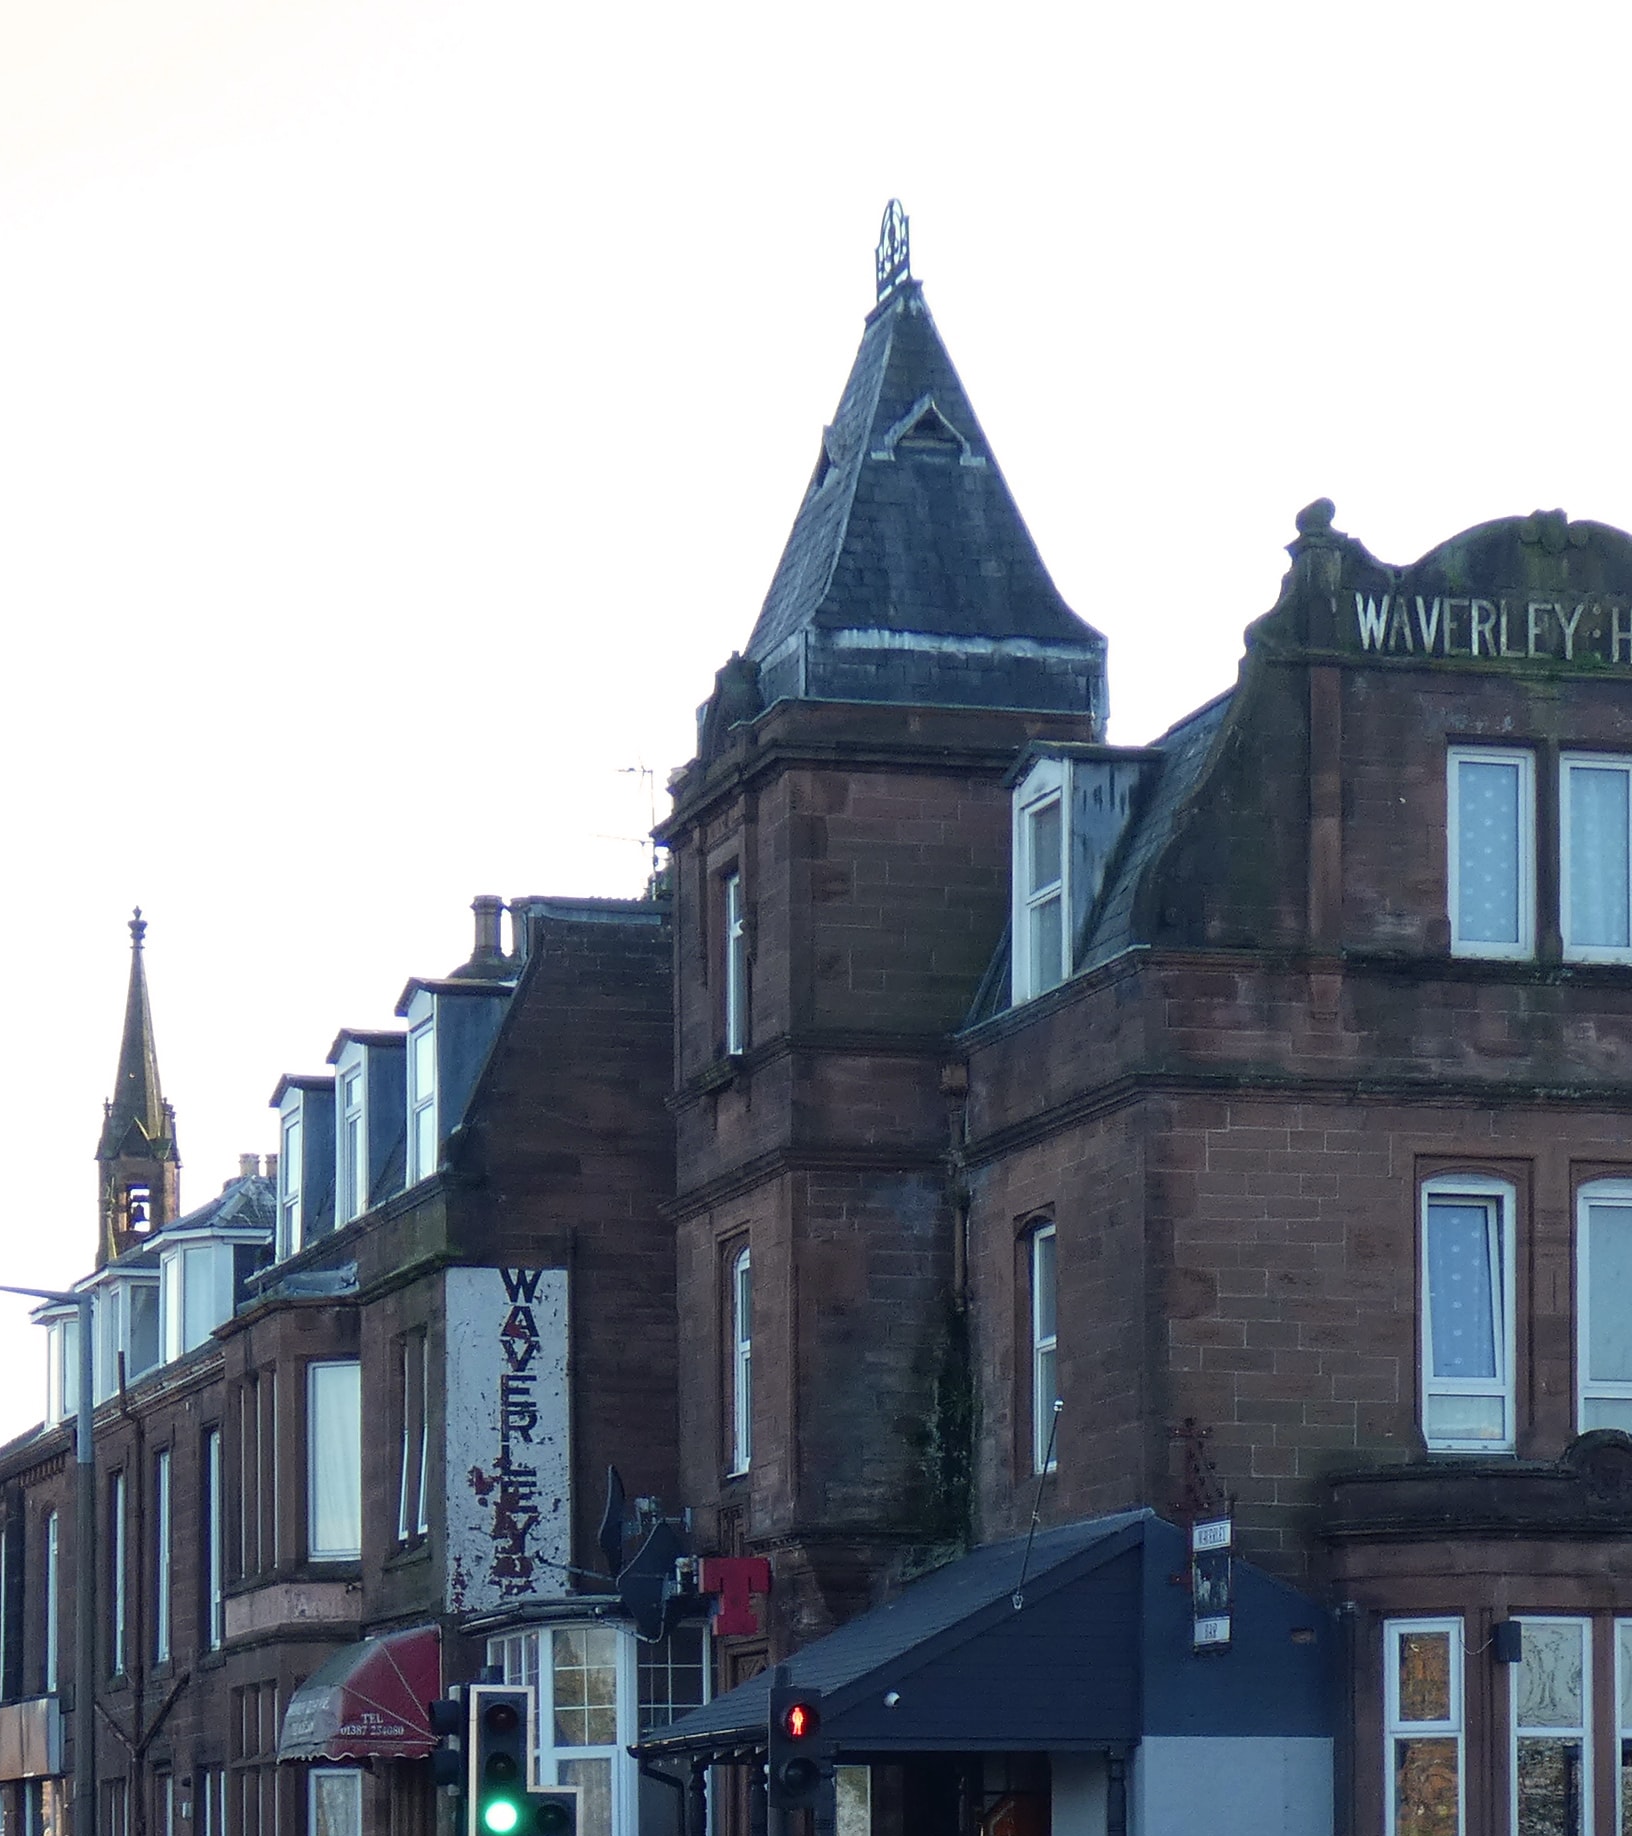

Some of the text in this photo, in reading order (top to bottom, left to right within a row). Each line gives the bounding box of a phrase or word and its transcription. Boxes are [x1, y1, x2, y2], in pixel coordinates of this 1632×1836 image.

[1355, 591, 1584, 660] WAVERLEY
[360, 1713, 384, 1724] TEL
[340, 1725, 368, 1736] 01387
